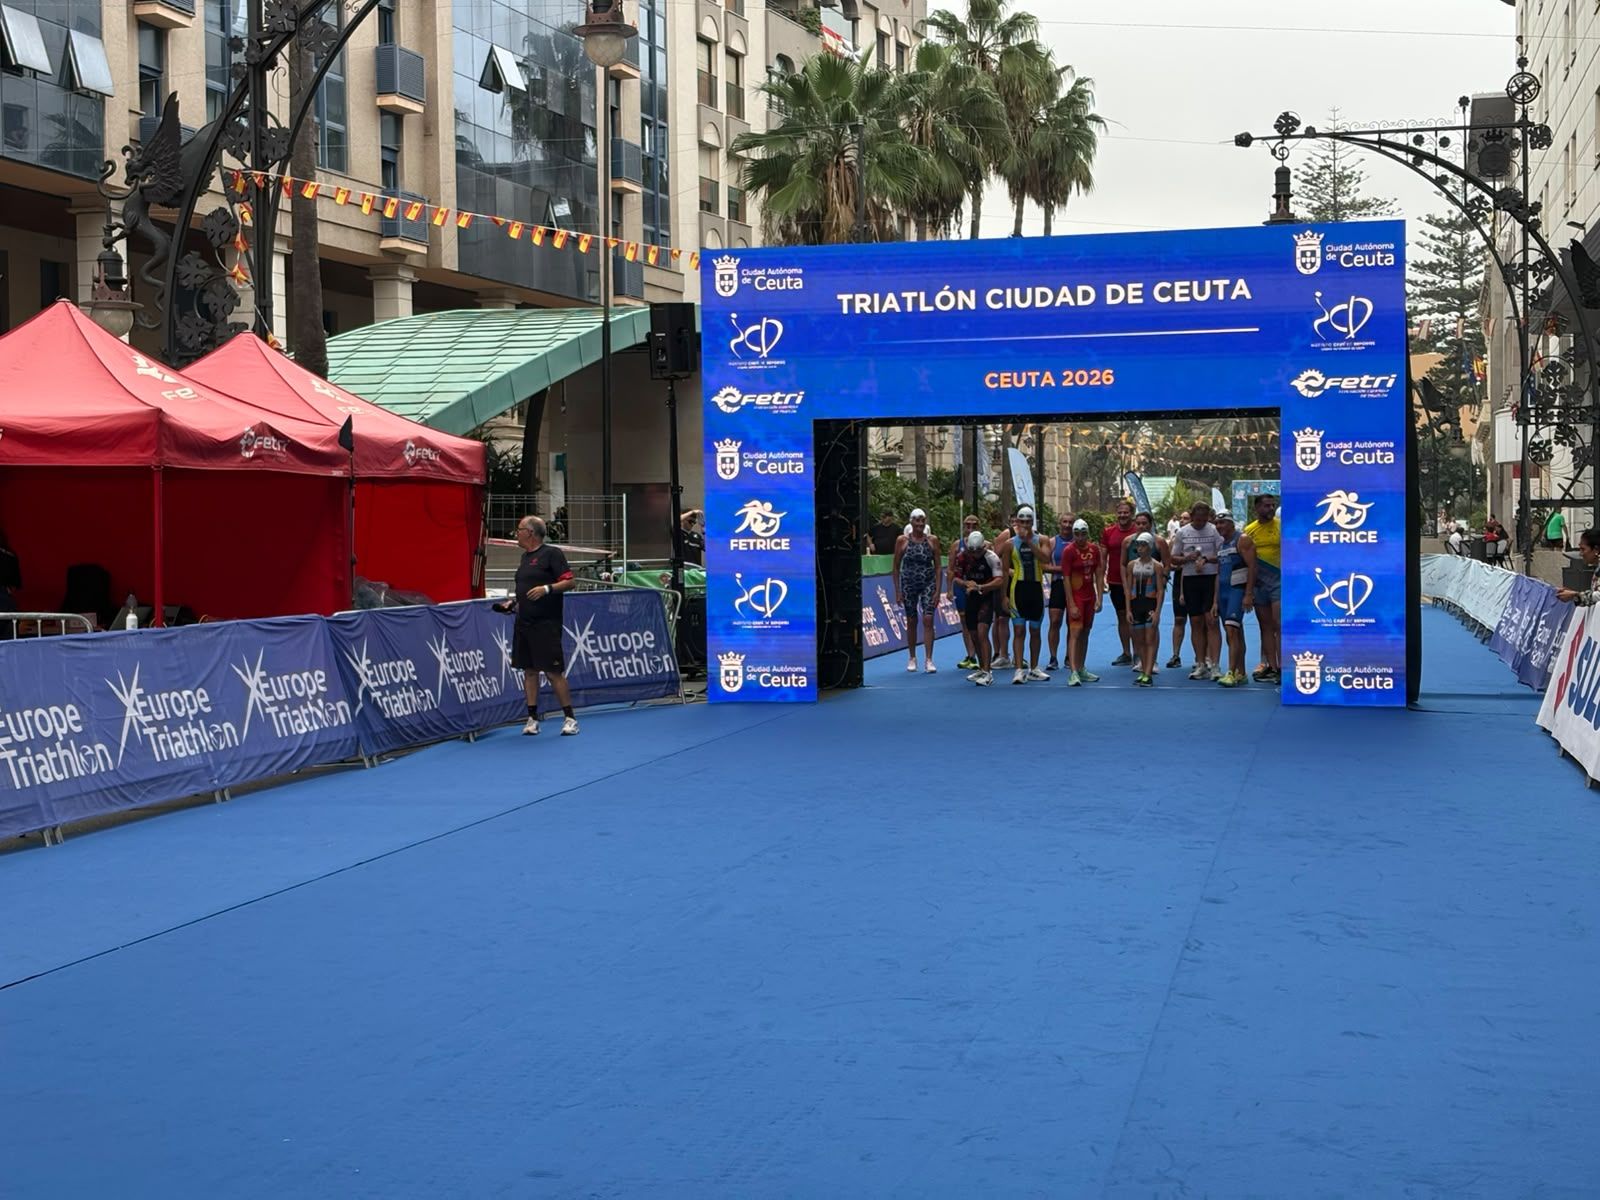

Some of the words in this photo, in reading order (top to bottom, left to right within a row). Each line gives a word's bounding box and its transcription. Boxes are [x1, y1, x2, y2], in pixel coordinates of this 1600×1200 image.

[1354, 241, 1395, 251] Autónoma
[1325, 253, 1337, 261] de
[1339, 252, 1395, 268] Ceuta
[741, 268, 766, 276] Ciudad
[767, 267, 803, 275] Autónoma
[741, 276, 752, 285] de
[754, 275, 803, 291] Ceuta
[836, 285, 976, 315] TRIATLÓN
[985, 285, 1096, 310] CIUDAD
[1105, 282, 1144, 305] DE
[1152, 278, 1252, 303] CEUTA
[984, 371, 1056, 389] CEUTA
[1061, 368, 1115, 387] 2026
[1354, 440, 1395, 448] Autónoma
[742, 452, 767, 460] Ciudad
[768, 451, 804, 459] Autónoma
[1325, 450, 1337, 459] de
[1339, 449, 1395, 465] Ceuta
[742, 460, 753, 468] de
[755, 459, 804, 475] Ceuta
[729, 538, 791, 551] FETRICE
[1309, 530, 1378, 544] FETRICE
[585, 629, 655, 654] Europe
[366, 656, 418, 688] Europe
[445, 648, 487, 678] Europe
[588, 654, 675, 681] Triathlon
[772, 665, 808, 673] Autónoma
[1354, 665, 1395, 673] Autónoma
[258, 668, 328, 702] Europe
[450, 674, 501, 704] Triathlon
[746, 674, 757, 682] de
[759, 672, 808, 688] Ceuta
[1339, 674, 1395, 690] Ceuta
[134, 686, 212, 724] Europe
[373, 687, 439, 718] Triathlon
[0, 703, 84, 744] Europe
[265, 697, 353, 738] Triathlon
[143, 720, 240, 763] Triathlon
[0, 739, 114, 790] Triathlon
